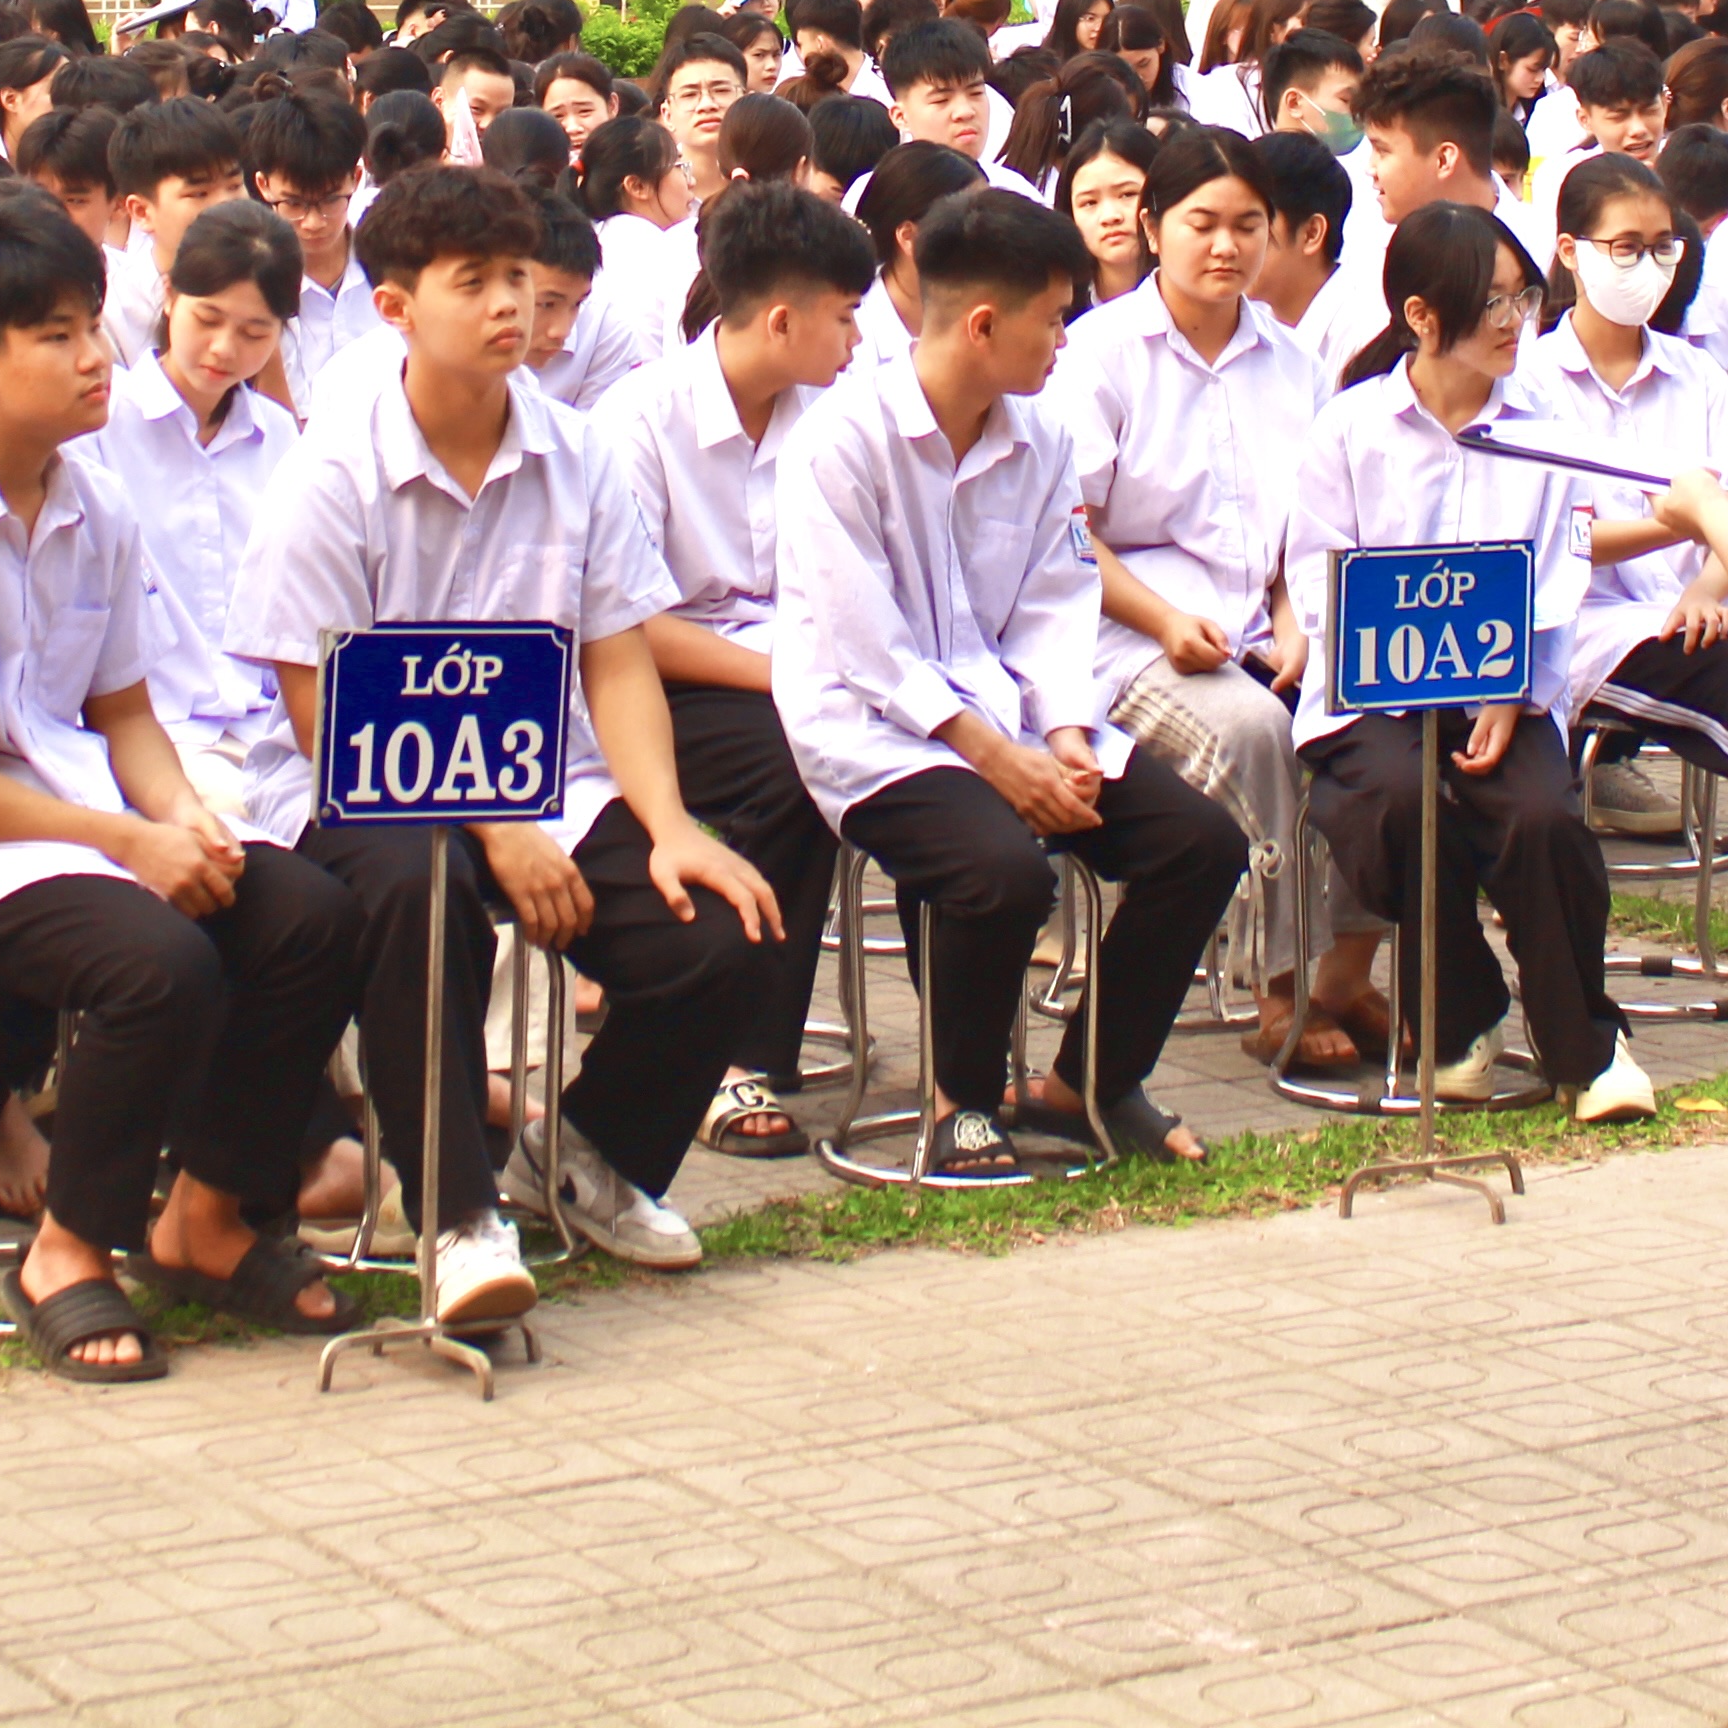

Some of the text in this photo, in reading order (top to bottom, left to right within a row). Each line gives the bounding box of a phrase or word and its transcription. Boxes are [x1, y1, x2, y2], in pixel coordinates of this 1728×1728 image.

[1395, 559, 1476, 609] LỚP
[400, 642, 504, 696] LỚP
[1354, 619, 1514, 686] 10A2
[346, 714, 545, 804] 10A3
